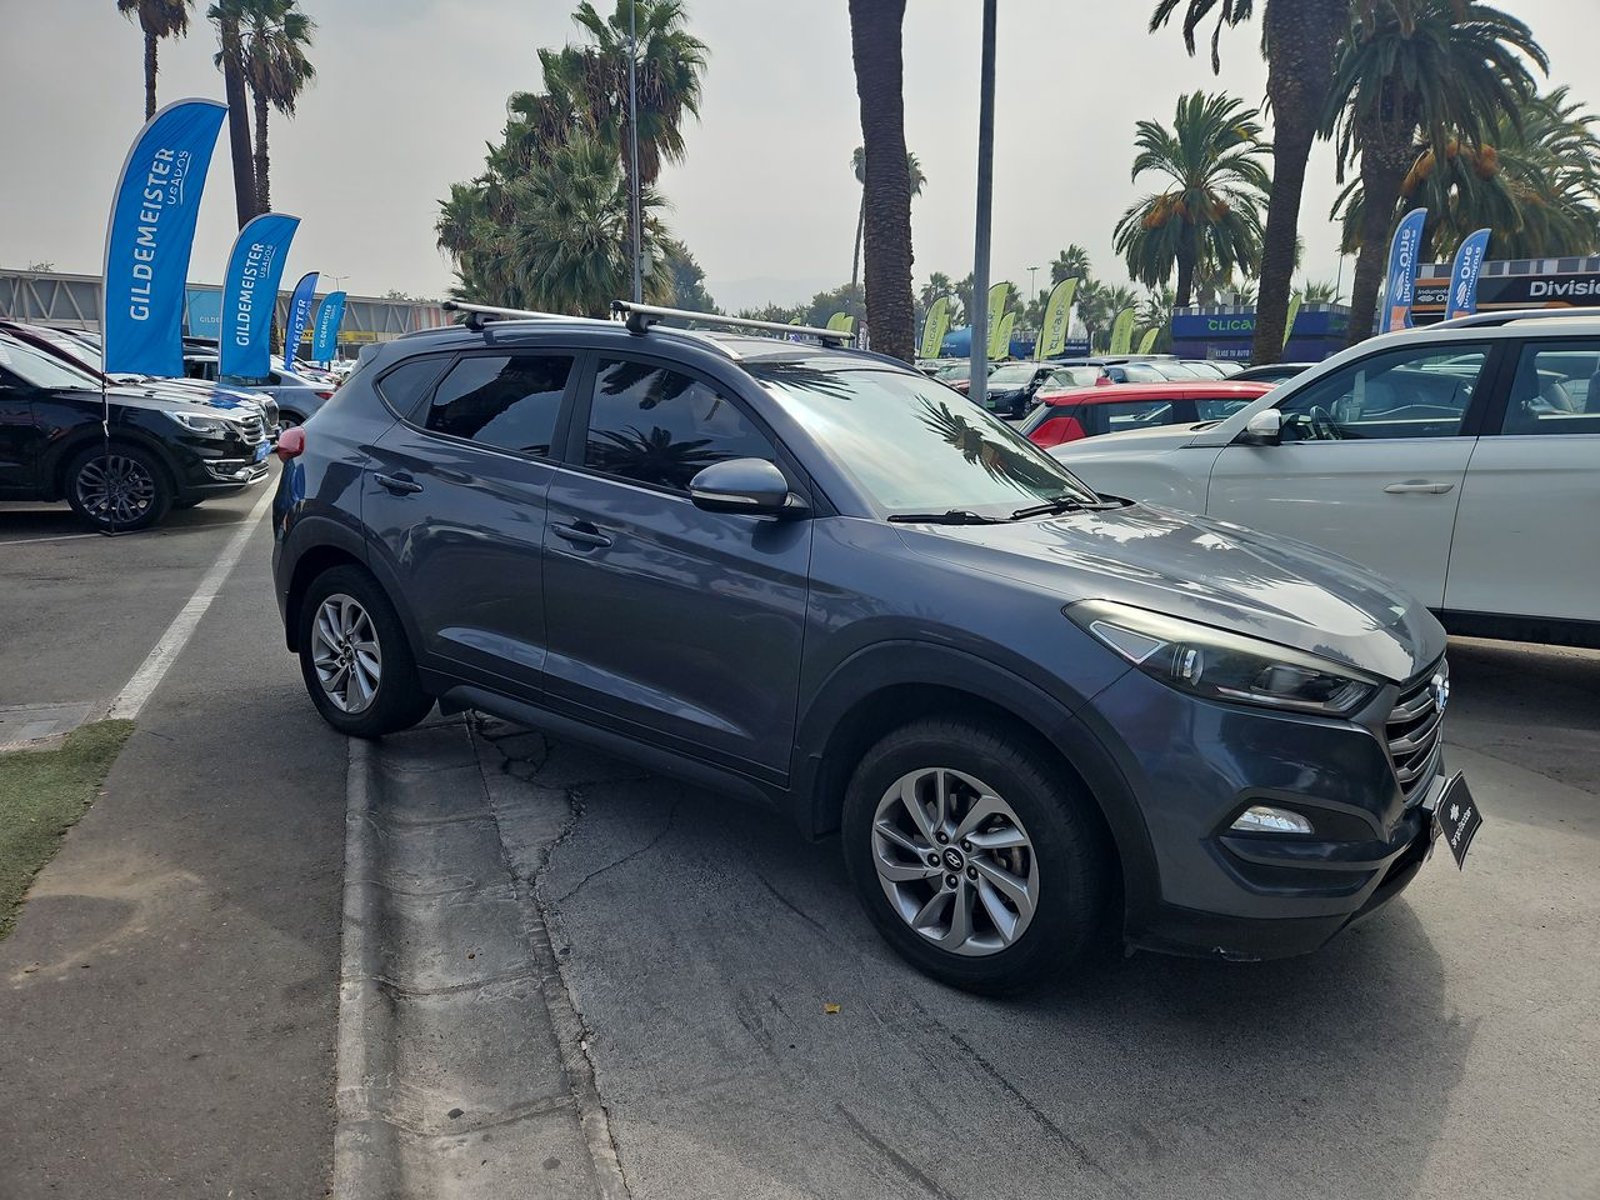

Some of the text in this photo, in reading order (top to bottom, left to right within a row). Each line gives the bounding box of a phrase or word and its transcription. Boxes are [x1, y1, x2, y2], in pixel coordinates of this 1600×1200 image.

[167, 150, 189, 205] USADOS
[130, 148, 175, 321] GILDEMEISTER
[259, 245, 274, 278] USADOS
[236, 243, 264, 346] GILDEMEISTER
[1208, 318, 1255, 331] CLICA
